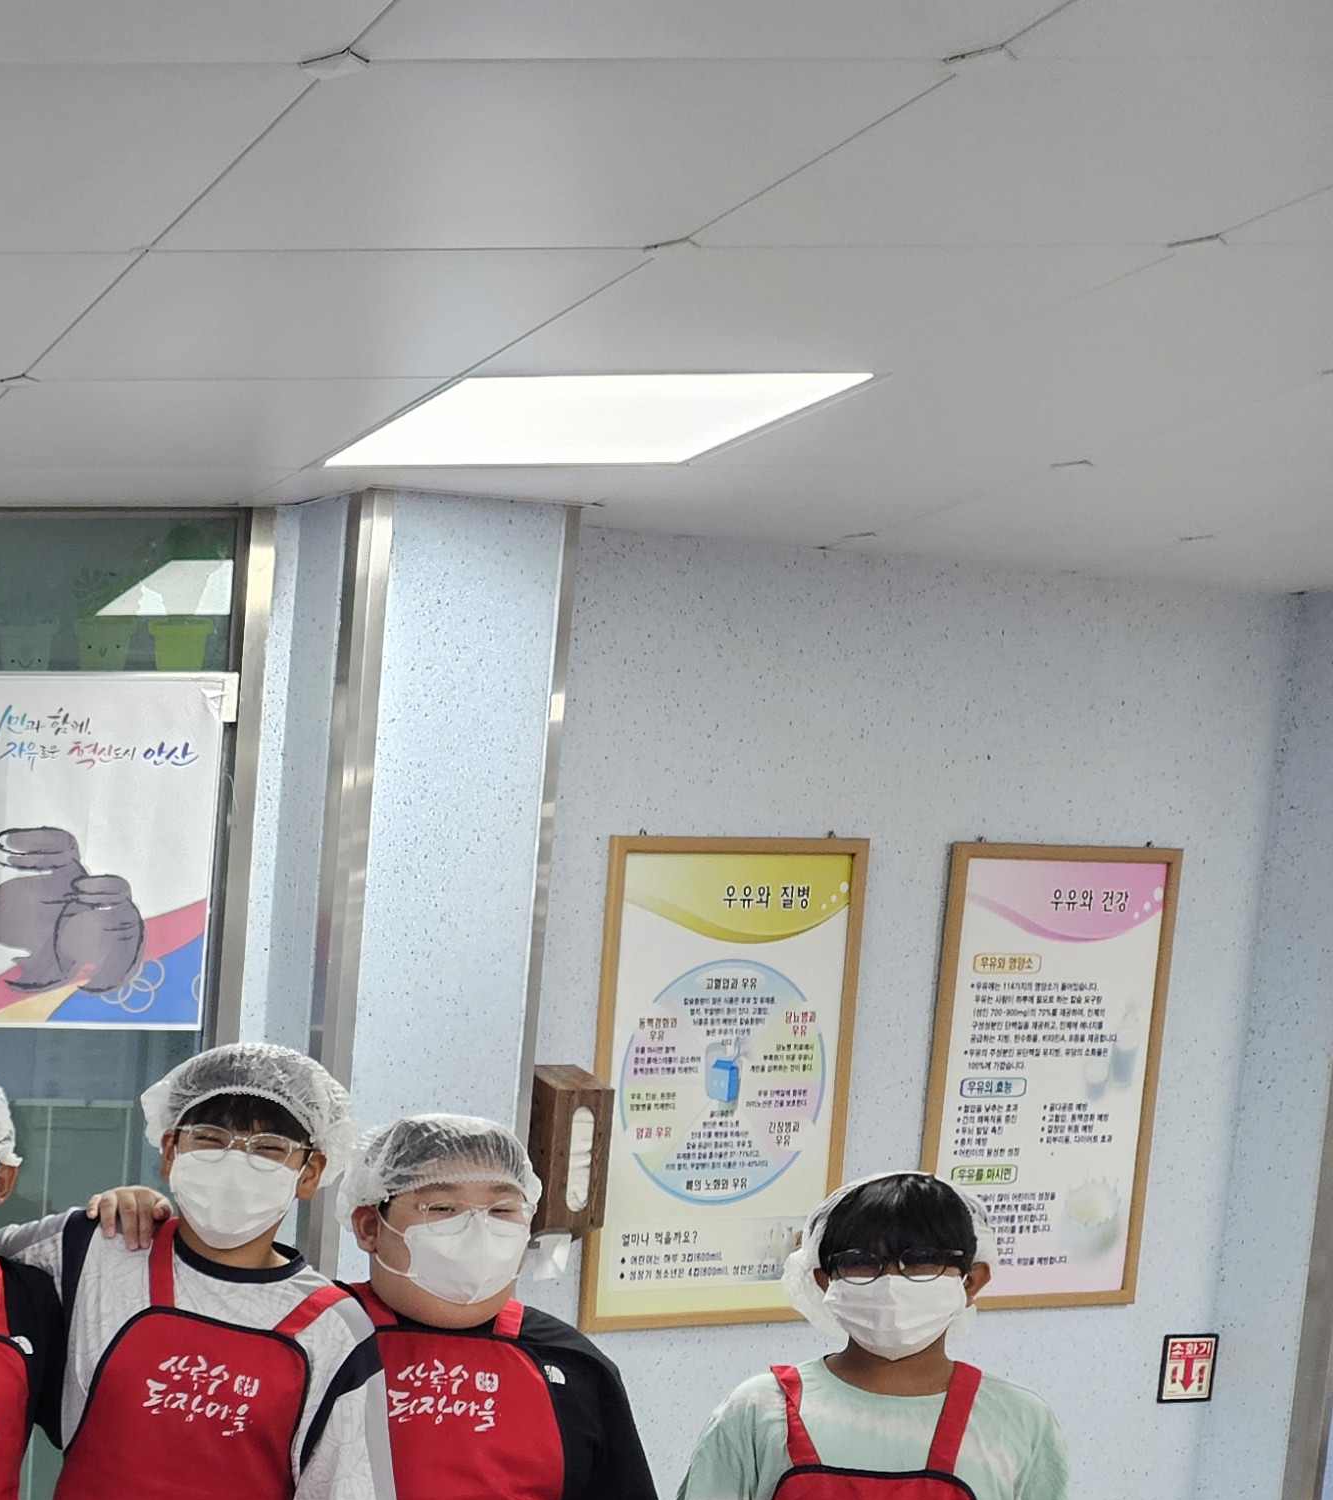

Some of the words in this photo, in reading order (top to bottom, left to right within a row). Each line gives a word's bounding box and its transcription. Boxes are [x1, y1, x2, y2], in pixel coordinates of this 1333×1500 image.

[143, 741, 200, 766] 안산
[722, 885, 771, 910] 우유와
[780, 884, 811, 909] 질병
[1049, 888, 1094, 913] 우유와
[1100, 888, 1130, 913] 건강
[980, 957, 1006, 970] 우유와
[741, 978, 757, 989] 우유
[649, 1030, 665, 1041] 우유
[792, 1025, 807, 1037] 우유
[967, 1081, 993, 1094] 우유의
[995, 1081, 1013, 1093] 효능
[656, 1126, 672, 1138] 우유
[775, 1135, 790, 1146] 우유
[986, 1168, 1011, 1181] 마시면
[732, 1178, 747, 1190] 우유
[621, 1232, 649, 1247] 얼마나
[655, 1231, 698, 1246] 먹을까요?
[1171, 1341, 1212, 1356] 소화기
